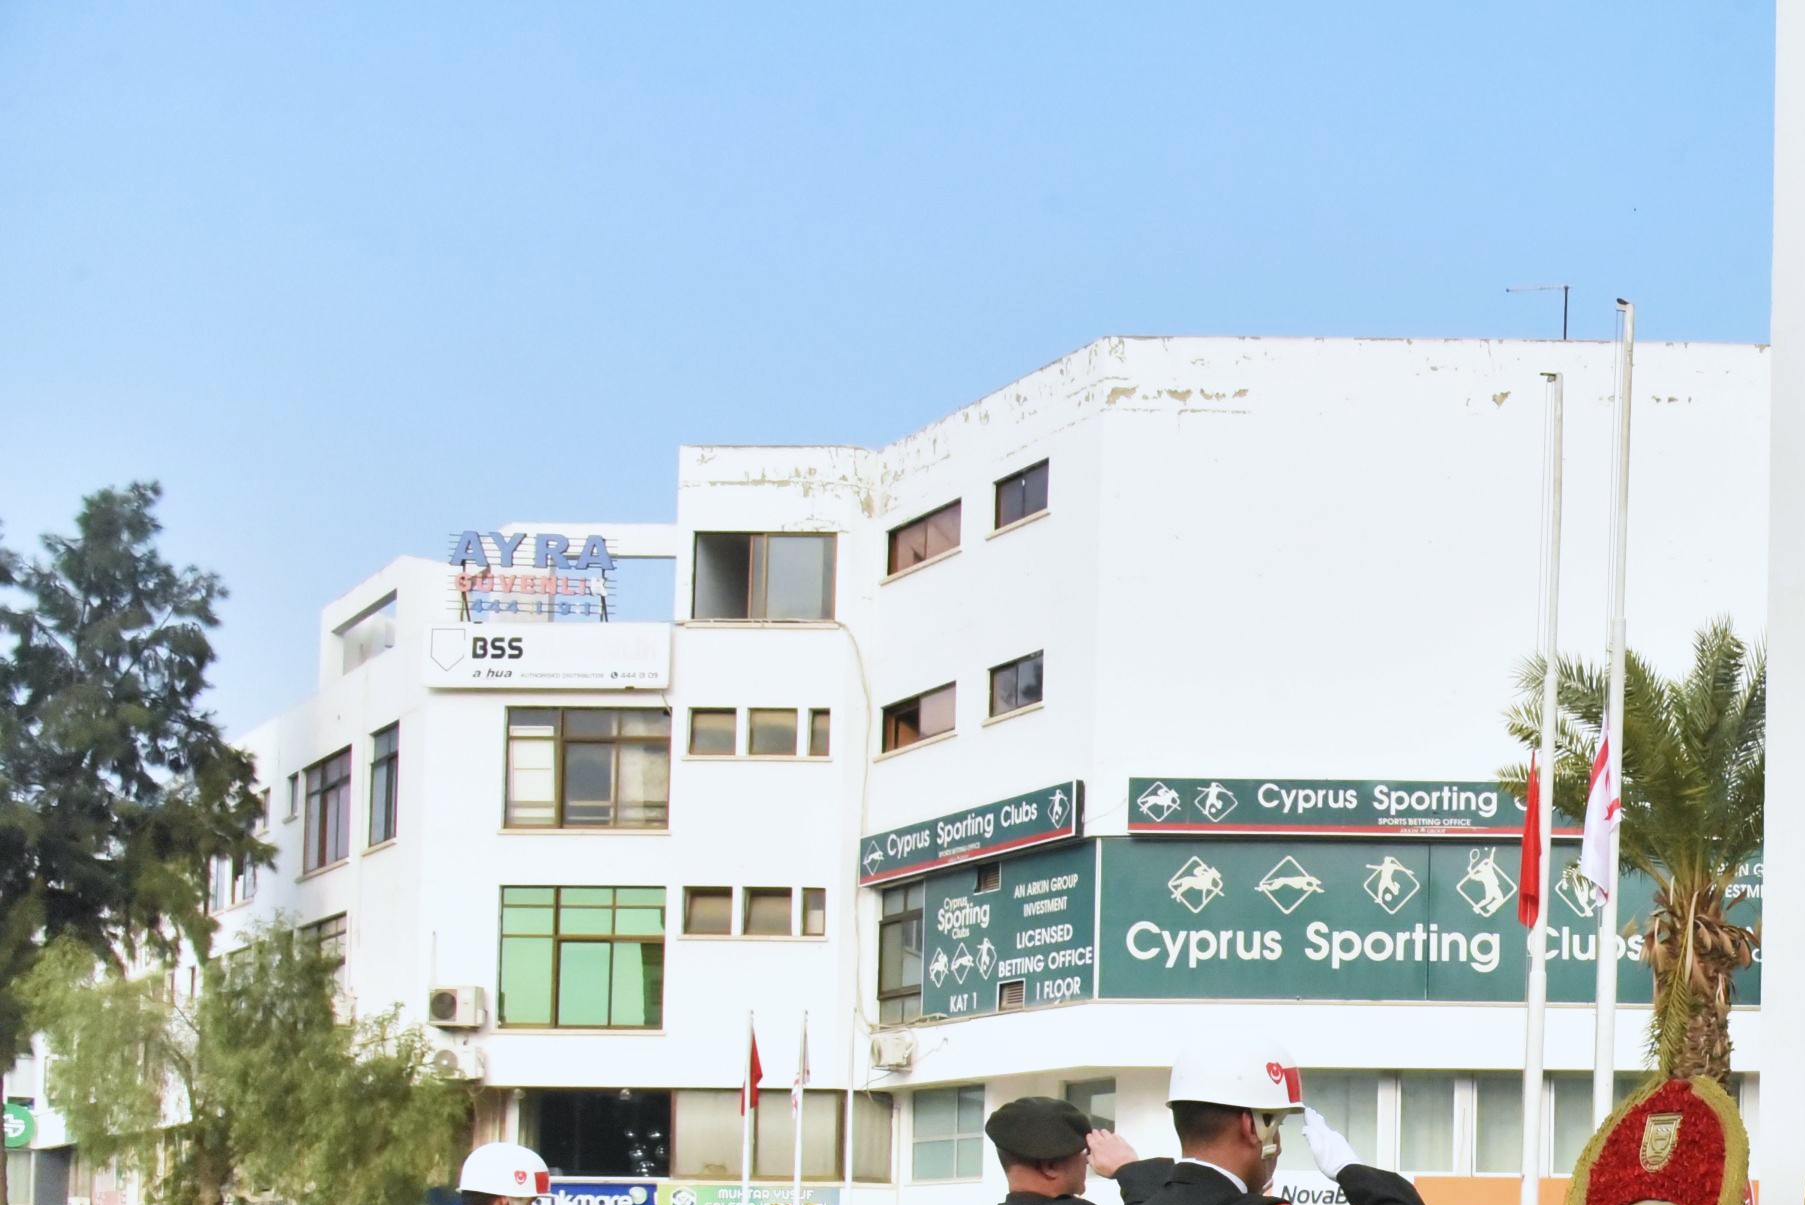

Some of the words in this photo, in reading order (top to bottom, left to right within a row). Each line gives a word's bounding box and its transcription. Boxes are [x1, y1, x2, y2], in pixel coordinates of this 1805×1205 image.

[449, 531, 617, 570] AYRA
[472, 637, 523, 659] BSS
[1257, 783, 1357, 814] Cyprus
[1372, 783, 1497, 818] Sporting
[887, 829, 930, 859] Cyprus
[936, 812, 995, 848] Sporting
[1000, 801, 1038, 828] Clubs
[1377, 817, 1407, 826] SPORTS
[1408, 818, 1441, 826] BETTING
[1442, 818, 1472, 826] OFFICE
[1014, 884, 1026, 899] AN
[1027, 879, 1050, 896] ARKIN
[1050, 873, 1079, 892] GROUP
[944, 896, 968, 911] Cyprus
[1023, 896, 1068, 917] INVESTMENT
[937, 902, 990, 935] Sporting
[952, 928, 970, 940] Clubs
[1016, 923, 1073, 950] LICENSED
[1126, 920, 1284, 970] Cyprus
[1304, 920, 1501, 973] Sporting
[998, 954, 1045, 978] BETTING
[1048, 946, 1093, 970] OFFICE
[1044, 976, 1081, 1000] FLOOR
[950, 993, 969, 1013] KAT
[972, 992, 977, 1009] 1
